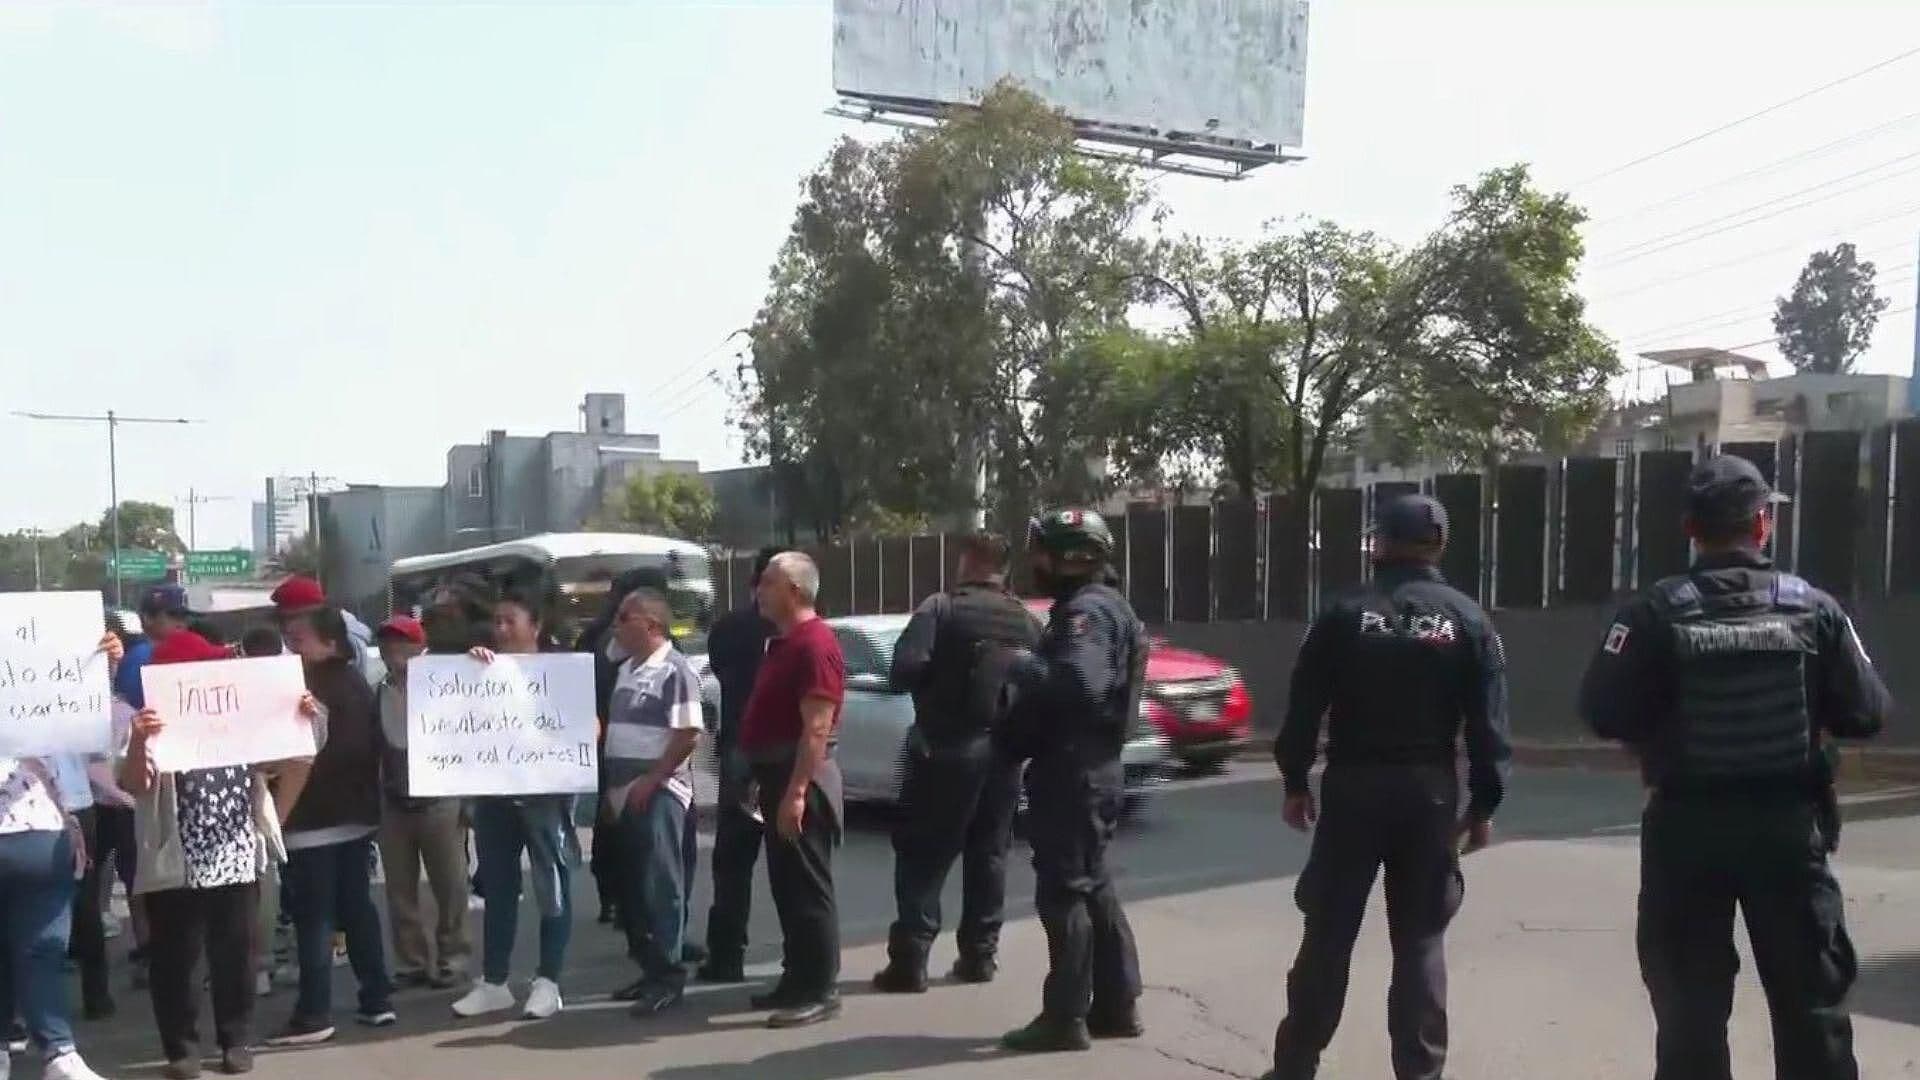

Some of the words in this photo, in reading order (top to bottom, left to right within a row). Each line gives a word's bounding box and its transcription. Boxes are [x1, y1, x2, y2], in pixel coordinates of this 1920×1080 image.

[16, 616, 36, 645] al
[49, 657, 83, 684] del
[527, 671, 549, 697] al
